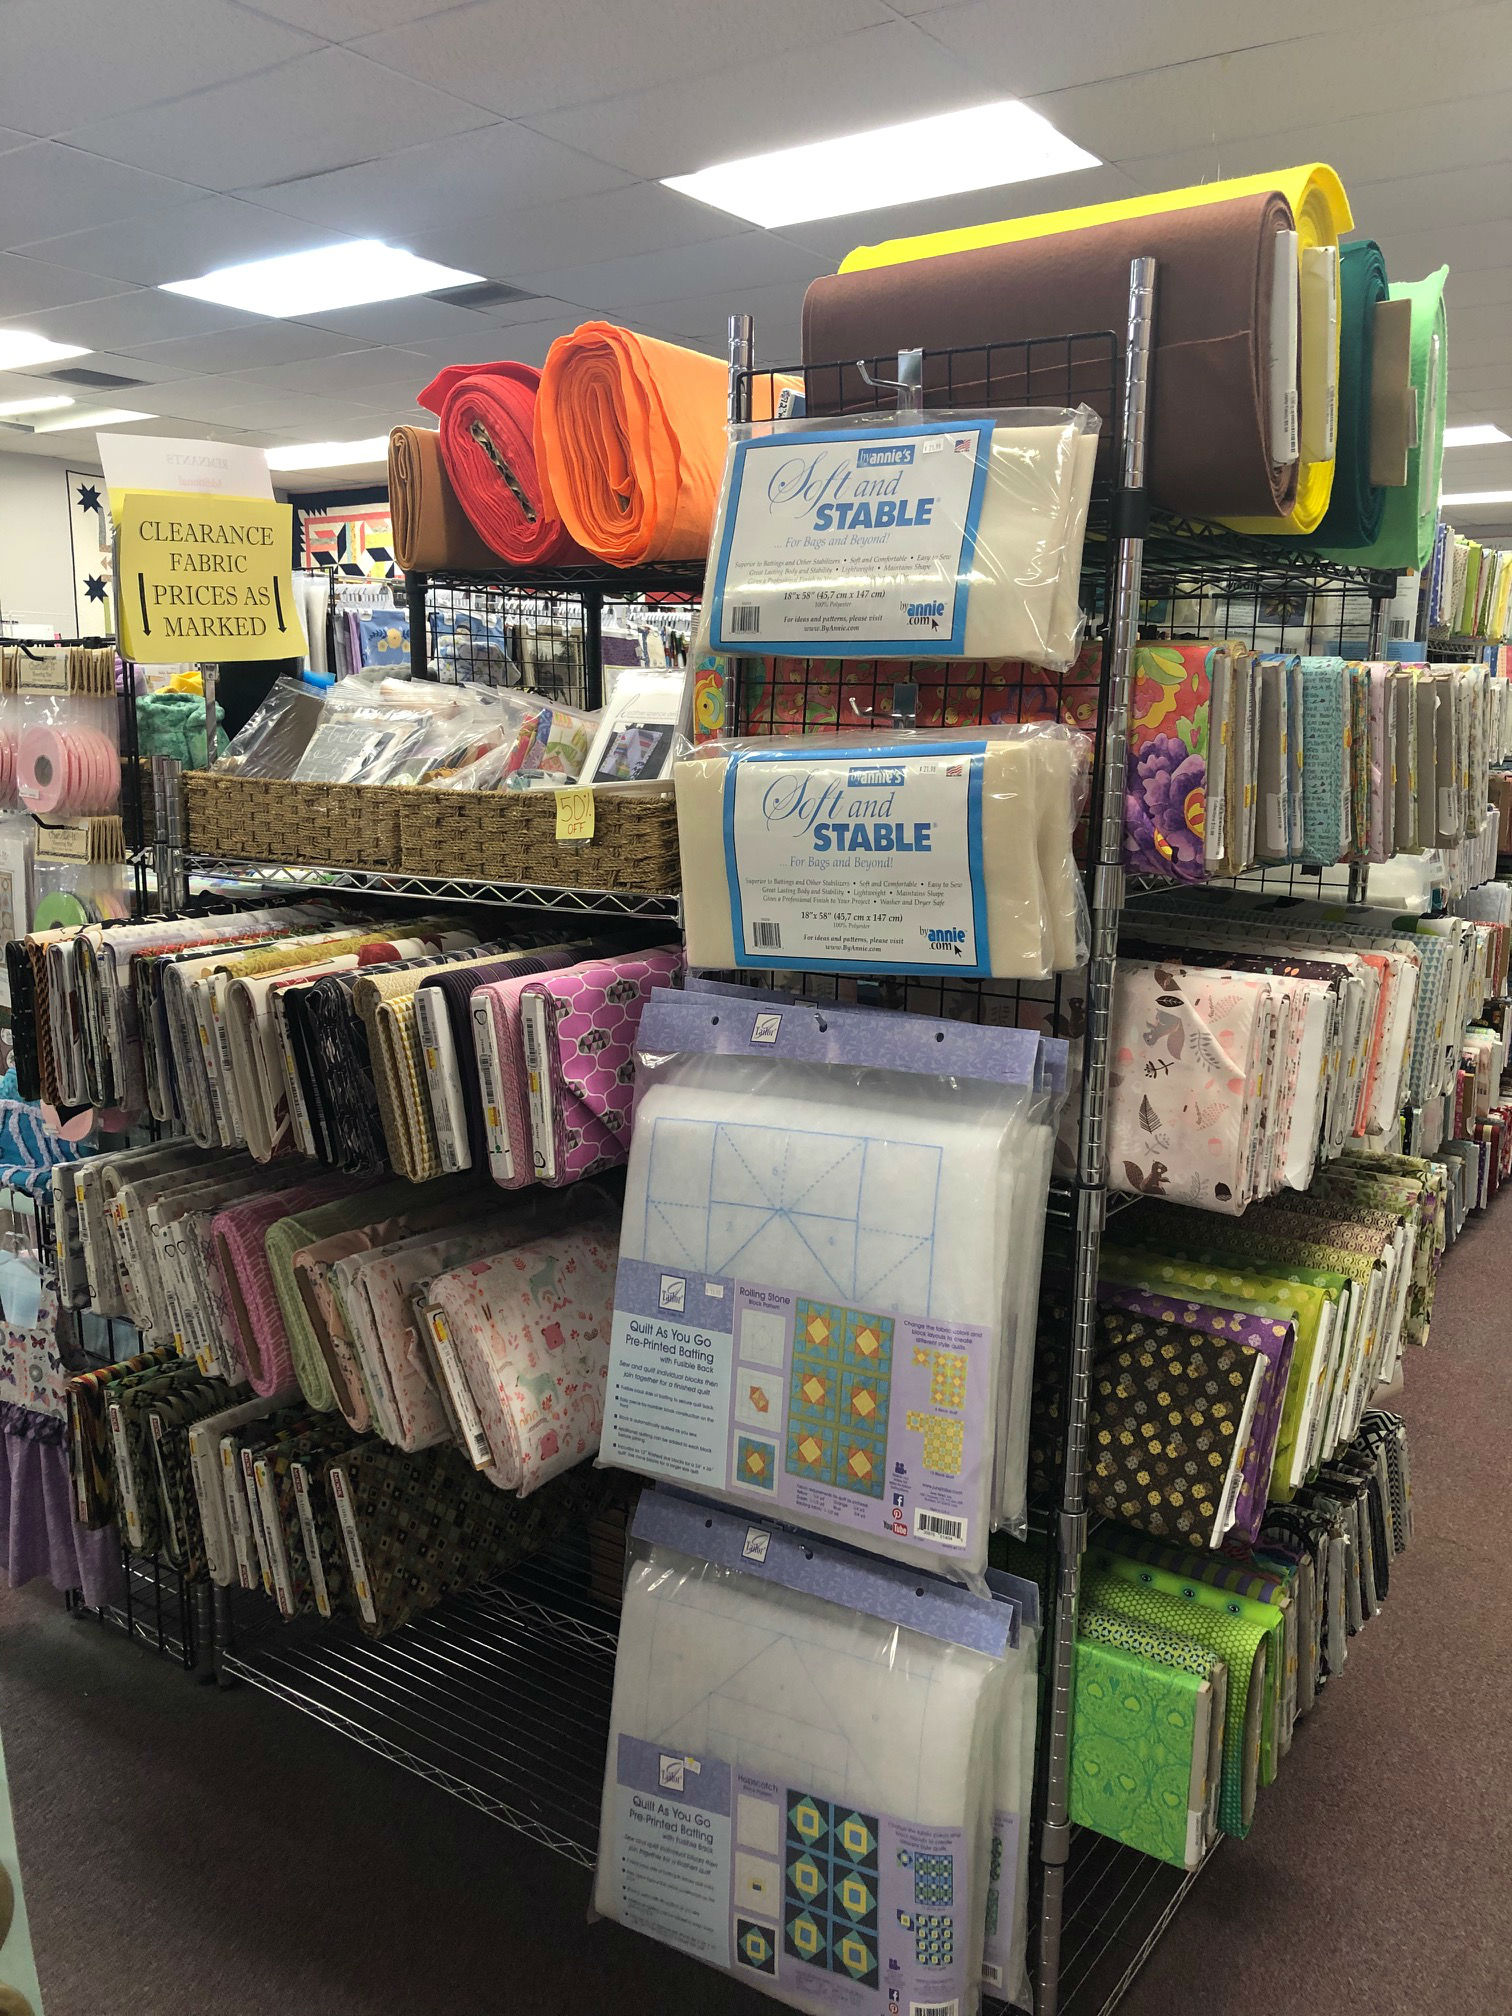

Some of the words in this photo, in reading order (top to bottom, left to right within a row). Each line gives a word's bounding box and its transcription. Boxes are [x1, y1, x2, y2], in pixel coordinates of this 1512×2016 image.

[768, 448, 852, 519] Soft
[853, 470, 903, 497] and
[813, 498, 935, 531] STABLE
[139, 520, 274, 546] CLEARANCE
[804, 536, 826, 550] Bags
[829, 535, 848, 546] and
[850, 534, 890, 548] Beyond!
[169, 552, 248, 573] FABRIC
[152, 584, 238, 606] PRICES
[243, 586, 271, 606] AS
[856, 590, 869, 599] 147
[871, 590, 886, 599] cm)
[163, 616, 267, 637] MARKED
[849, 615, 867, 624] please
[763, 768, 844, 838] Soft
[848, 791, 895, 818] and
[567, 821, 585, 835] OFF
[813, 822, 932, 852] STABLE
[808, 856, 830, 870] Bags
[832, 857, 850, 868] and
[854, 857, 893, 871] Beyond!
[927, 881, 941, 889] Easy
[888, 914, 903, 922] cm)
[869, 936, 888, 944] please
[740, 1286, 766, 1301] Rolling
[768, 1292, 791, 1305] Stone
[629, 1320, 653, 1336] Quilt
[655, 1326, 668, 1339] As
[671, 1328, 690, 1344] You
[694, 1334, 712, 1348] Go
[625, 1334, 676, 1355] Pre-Printed
[679, 1346, 714, 1365] Batting
[631, 1362, 642, 1370] and
[643, 1366, 656, 1374] quilt
[657, 1368, 684, 1380] individual
[684, 1375, 703, 1384] blocks
[705, 1379, 718, 1388] then
[660, 1356, 672, 1365] with
[674, 1359, 696, 1370] Fusible
[697, 1364, 714, 1373] Back
[623, 1371, 633, 1380] join
[635, 1373, 659, 1384] together
[674, 1381, 696, 1392] finished
[697, 1387, 710, 1395] quilt
[738, 1774, 778, 1793] Hopscotch
[632, 1796, 655, 1811] Quilt
[657, 1804, 669, 1816] As
[672, 1807, 691, 1822] You
[695, 1814, 711, 1828] Go
[681, 1824, 713, 1845] Batting
